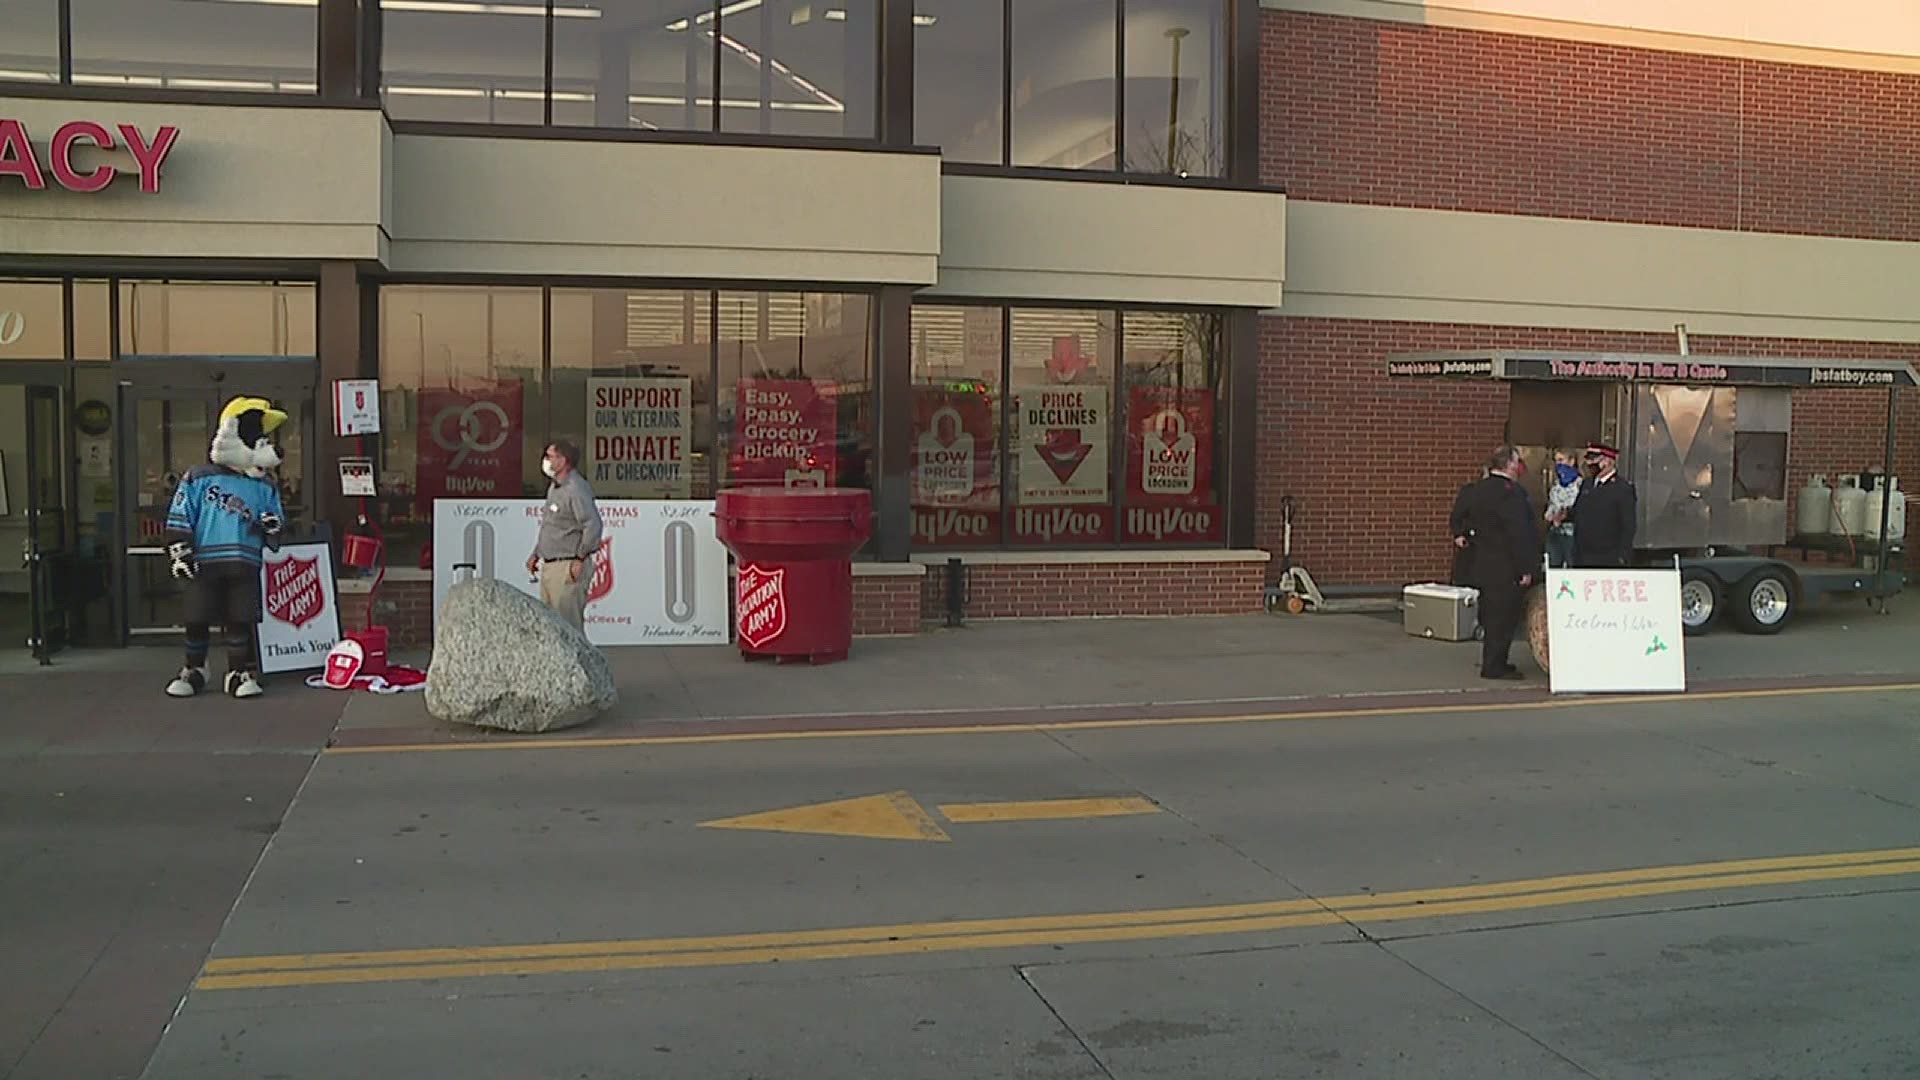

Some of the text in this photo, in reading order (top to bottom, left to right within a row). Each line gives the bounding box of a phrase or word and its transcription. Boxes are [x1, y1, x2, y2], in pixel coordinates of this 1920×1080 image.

[1551, 359, 1576, 376] The
[595, 387, 682, 408] SUPPORT
[745, 388, 792, 406] Easy.
[1042, 392, 1084, 409] PRICE
[595, 410, 618, 428] OUR
[745, 407, 803, 425] Peasy.
[1029, 409, 1097, 425] DECLINES
[745, 425, 818, 442] Grocery
[595, 435, 682, 461] DONATE
[1149, 449, 1189, 464] LOW
[924, 451, 967, 464] LOW
[595, 463, 611, 481] AT
[924, 466, 967, 479] PRICE
[1148, 465, 1188, 477] PRICE
[1016, 507, 1102, 542] HyVee
[1128, 507, 1210, 540] HyVee
[274, 560, 297, 587] THE
[268, 562, 317, 613] SALVATION
[1583, 580, 1649, 603] FREE
[289, 583, 317, 621] ARMY
[748, 598, 778, 636] ARMY
[265, 642, 306, 657] Thank
